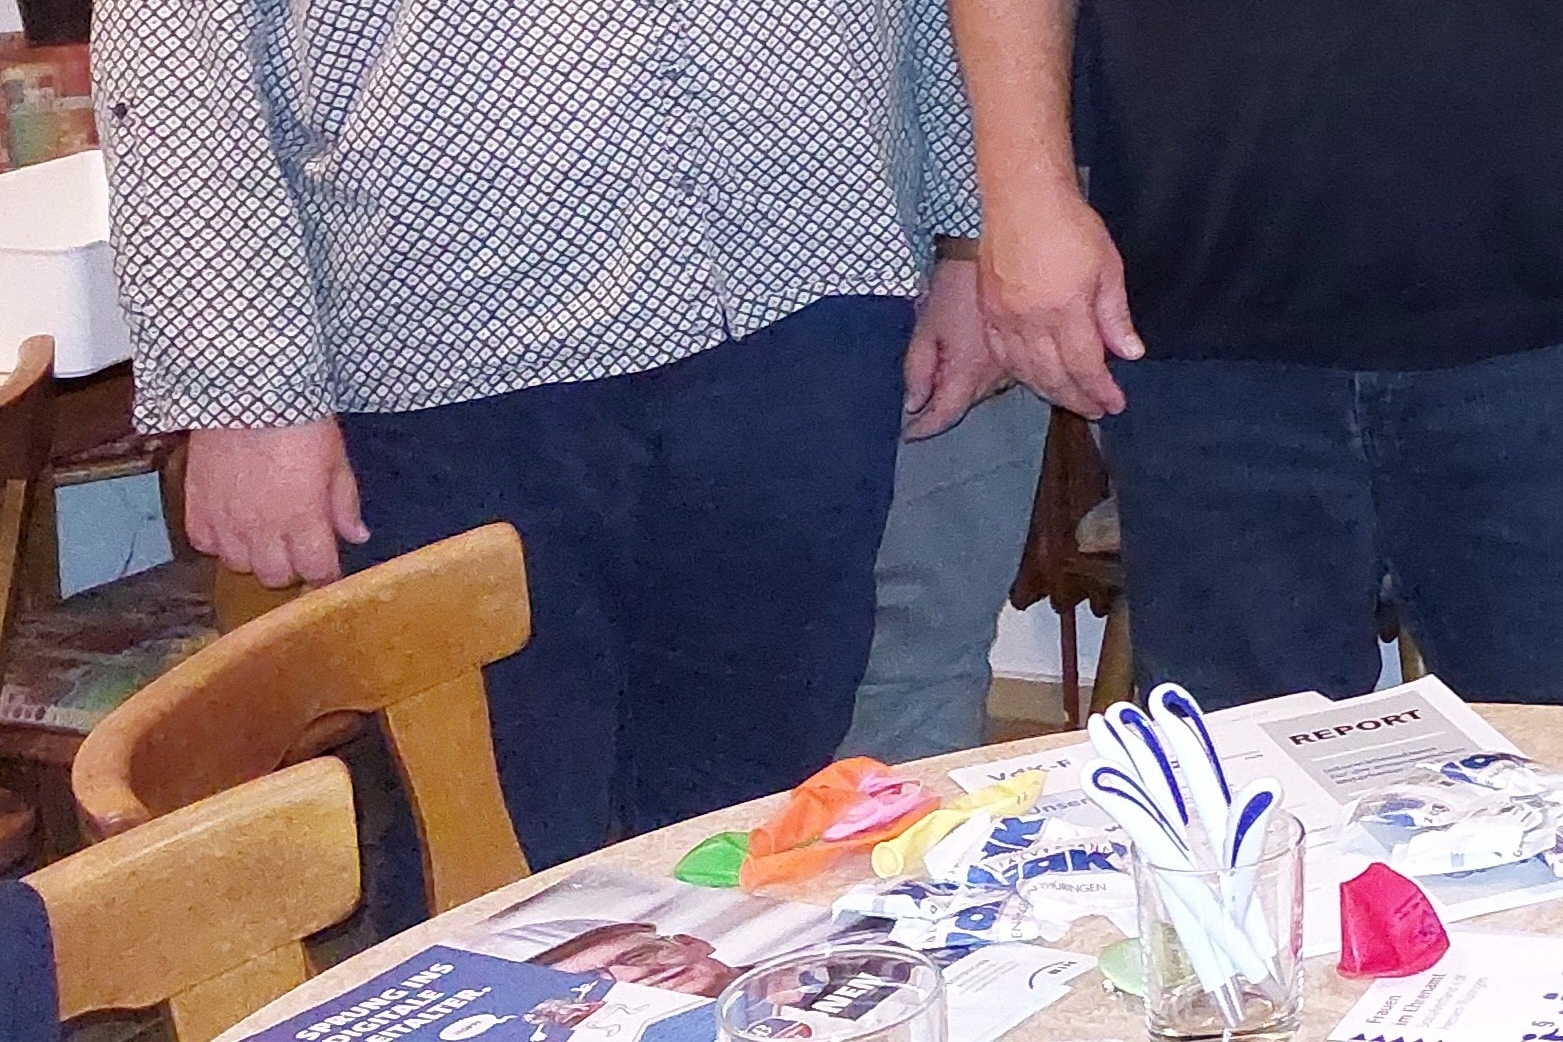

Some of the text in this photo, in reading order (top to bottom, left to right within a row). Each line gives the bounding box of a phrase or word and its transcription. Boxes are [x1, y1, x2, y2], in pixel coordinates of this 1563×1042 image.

[1289, 709, 1421, 745] REPORT
[295, 962, 455, 1041] SPRUNG INS
[322, 989, 445, 1042] DIGITALE
[1366, 995, 1402, 1024] Frauen
